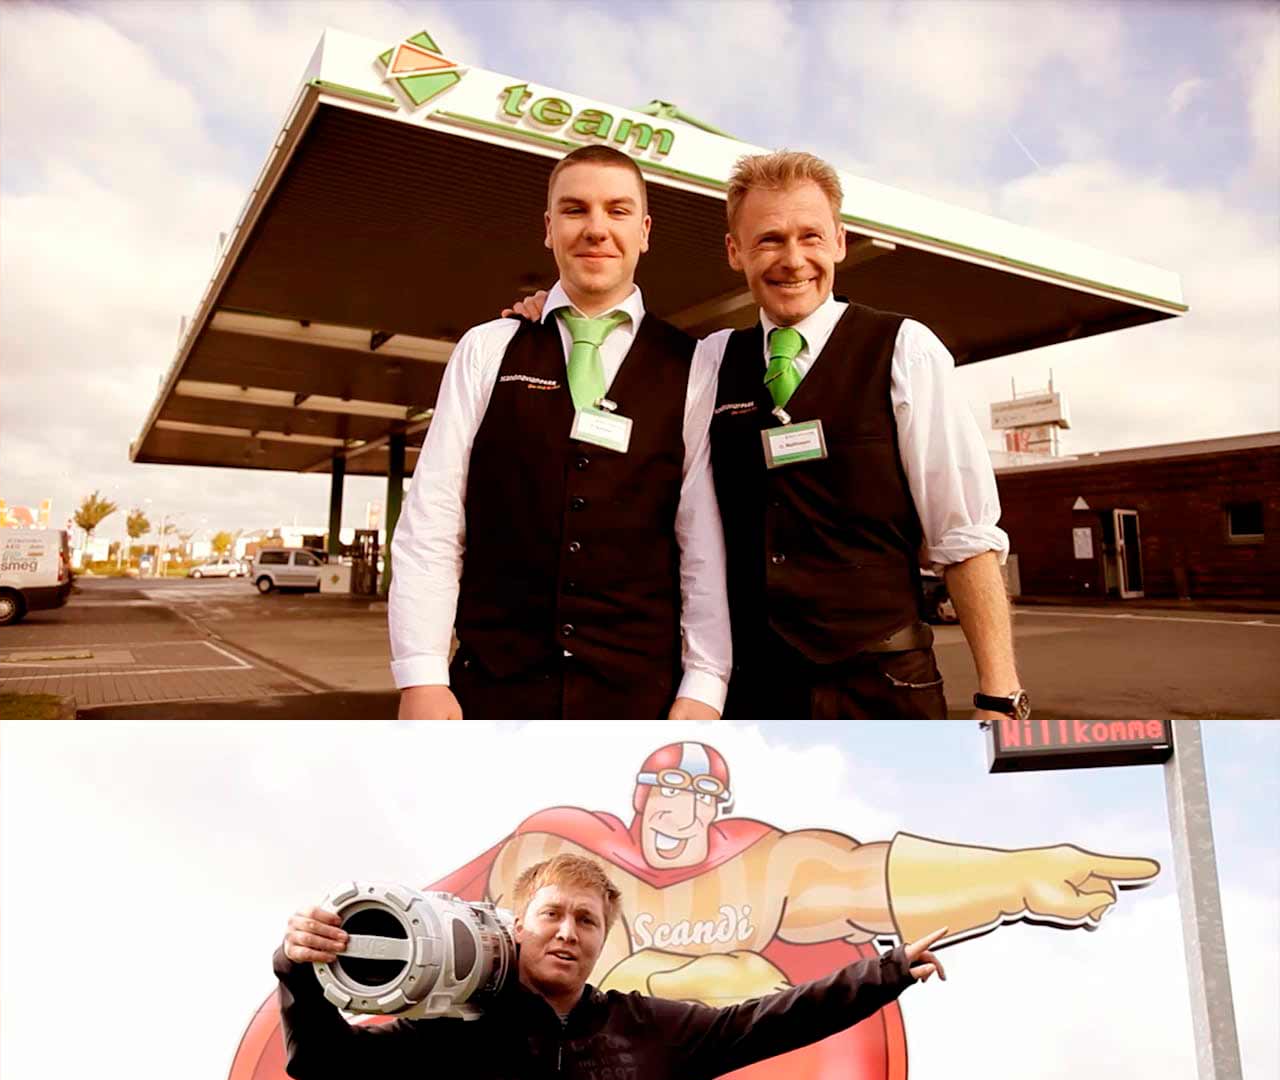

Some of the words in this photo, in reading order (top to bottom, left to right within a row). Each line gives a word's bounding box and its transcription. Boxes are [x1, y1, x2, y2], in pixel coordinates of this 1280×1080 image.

[498, 83, 676, 157] team
[1, 561, 38, 572] smeg
[631, 904, 756, 950] Scandi
